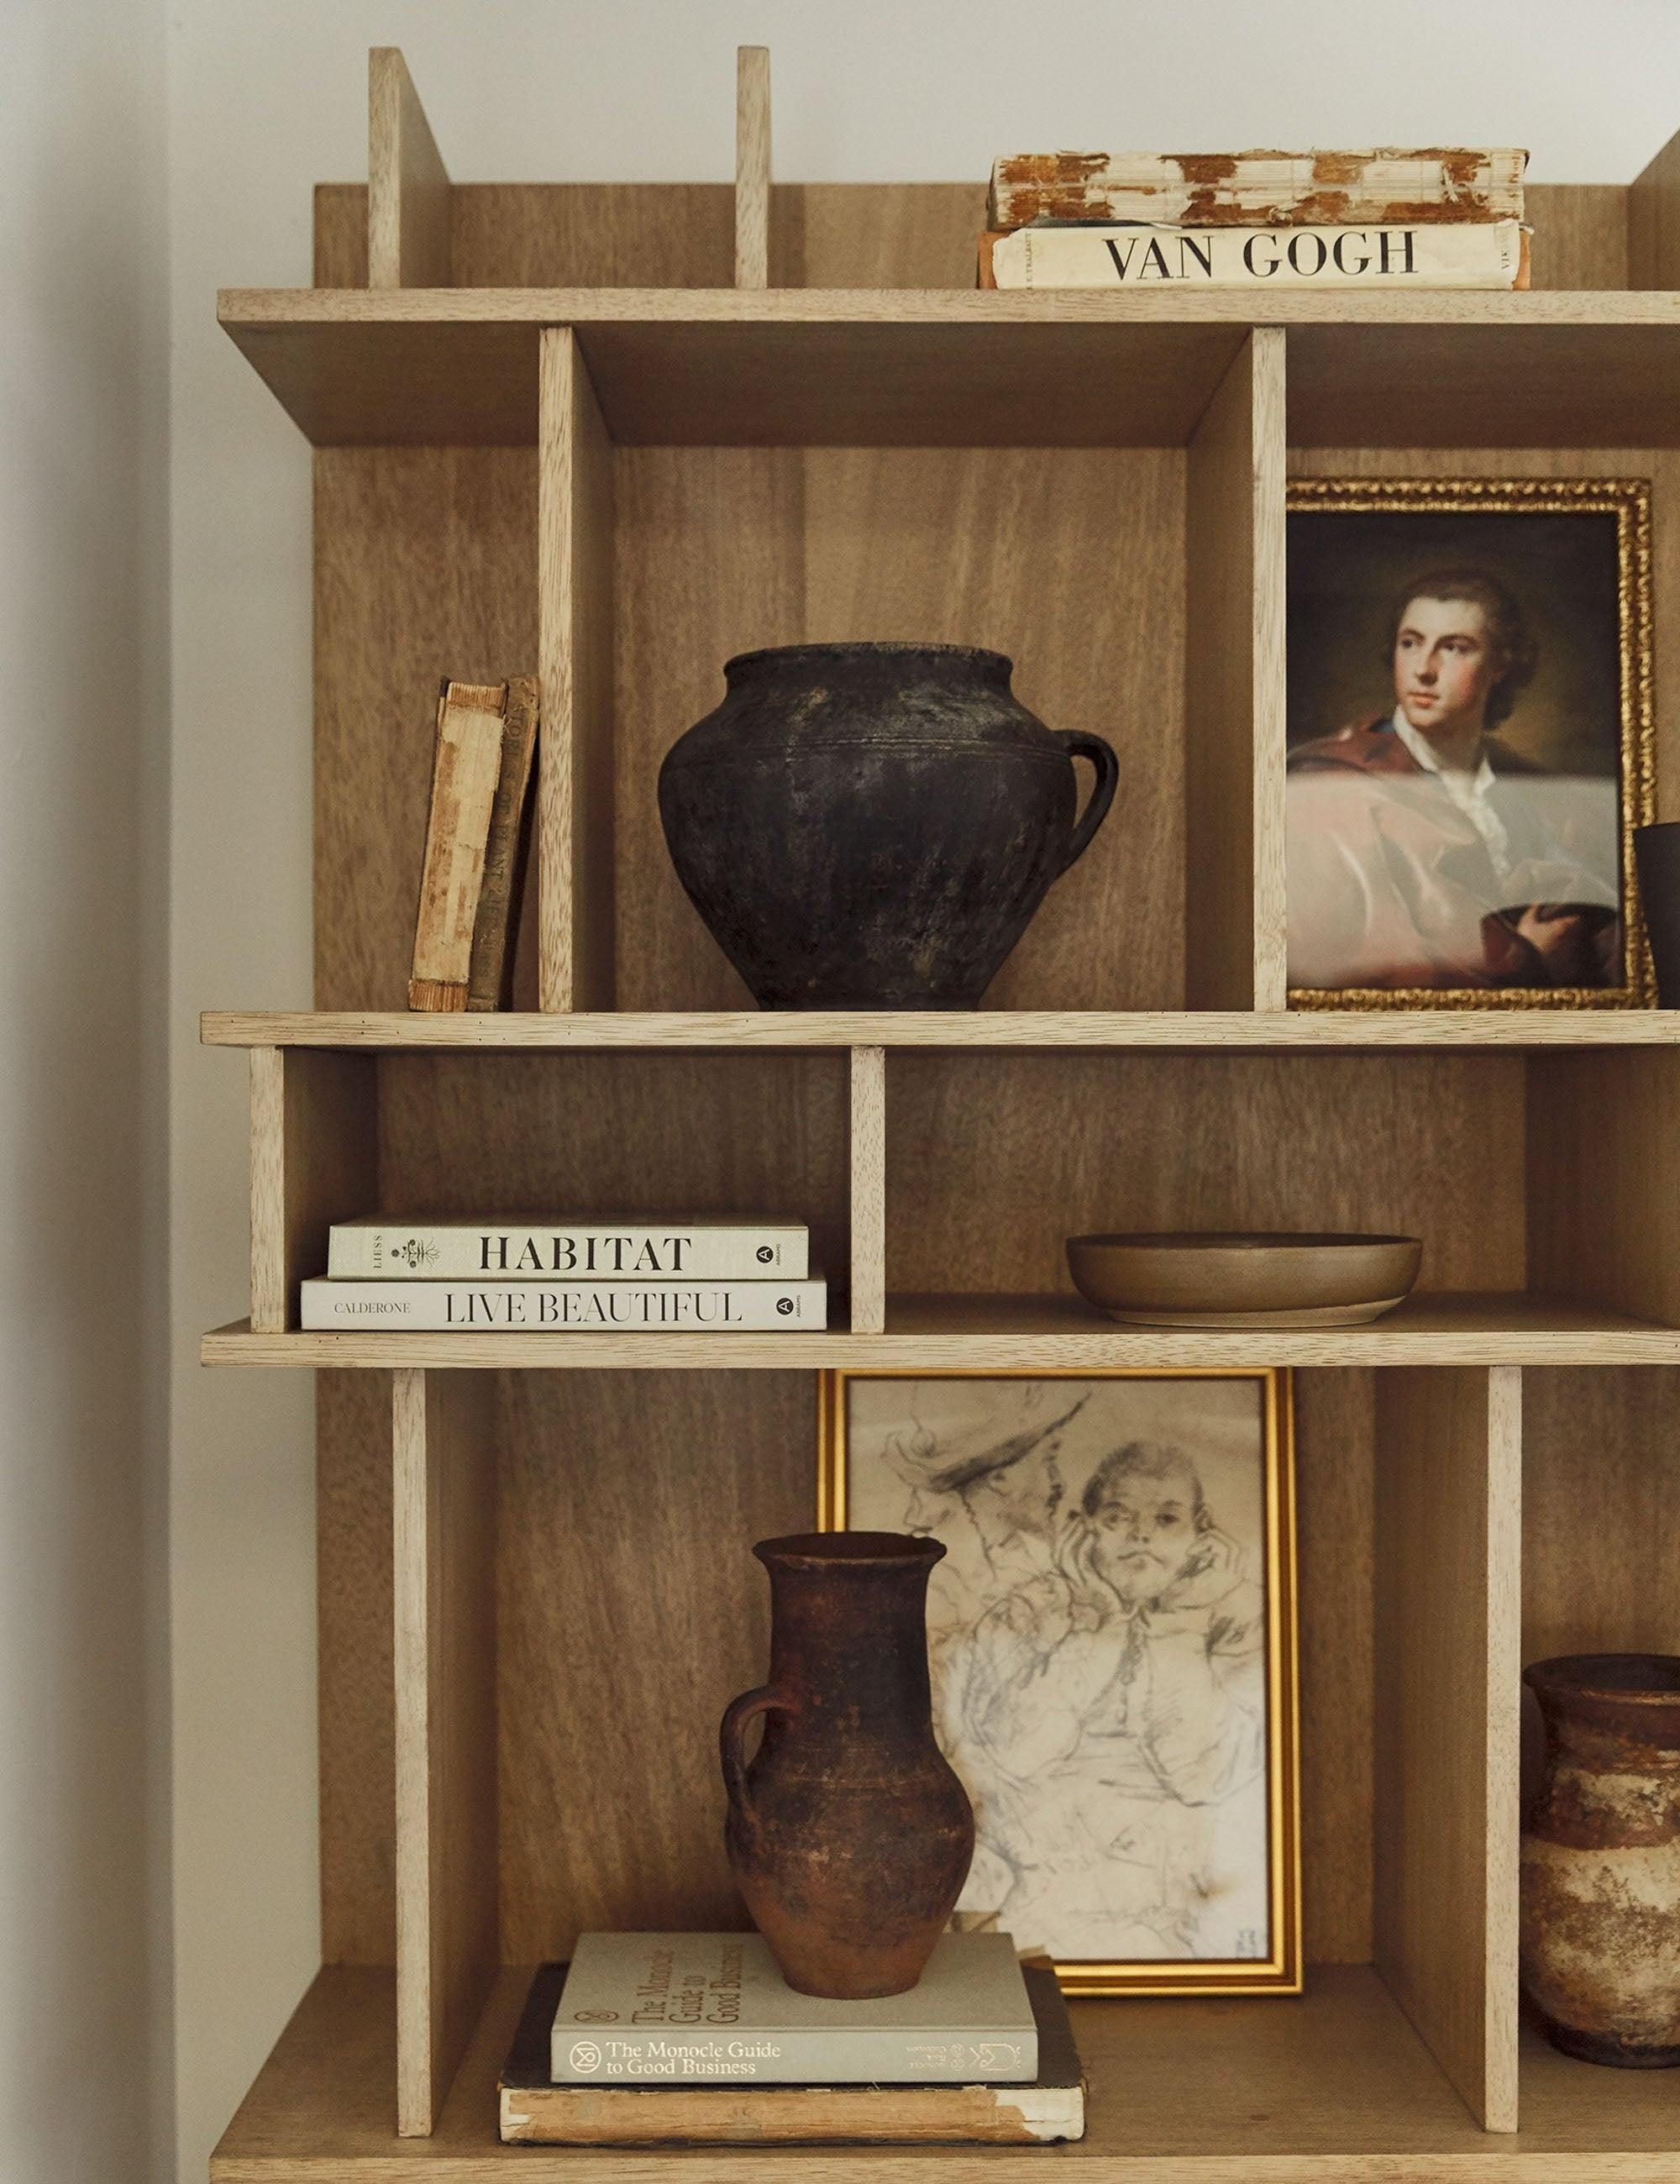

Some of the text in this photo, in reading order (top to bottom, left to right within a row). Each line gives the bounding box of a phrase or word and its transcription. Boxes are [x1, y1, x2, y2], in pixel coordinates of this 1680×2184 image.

[1101, 230, 1419, 281] VAN GOGH
[374, 1235, 382, 1268] LIESS
[480, 1236, 692, 1271] HABITAT
[333, 1302, 411, 1314] CALDERONE
[444, 1292, 743, 1322] LIVE BEAUTIFUL
[632, 1948, 674, 2024] The Monocle
[669, 1975, 706, 2023] Guide to
[706, 1943, 743, 2023] Good Business
[606, 2041, 781, 2058] The Monocle Guide
[606, 2058, 756, 2075] to Good Business
